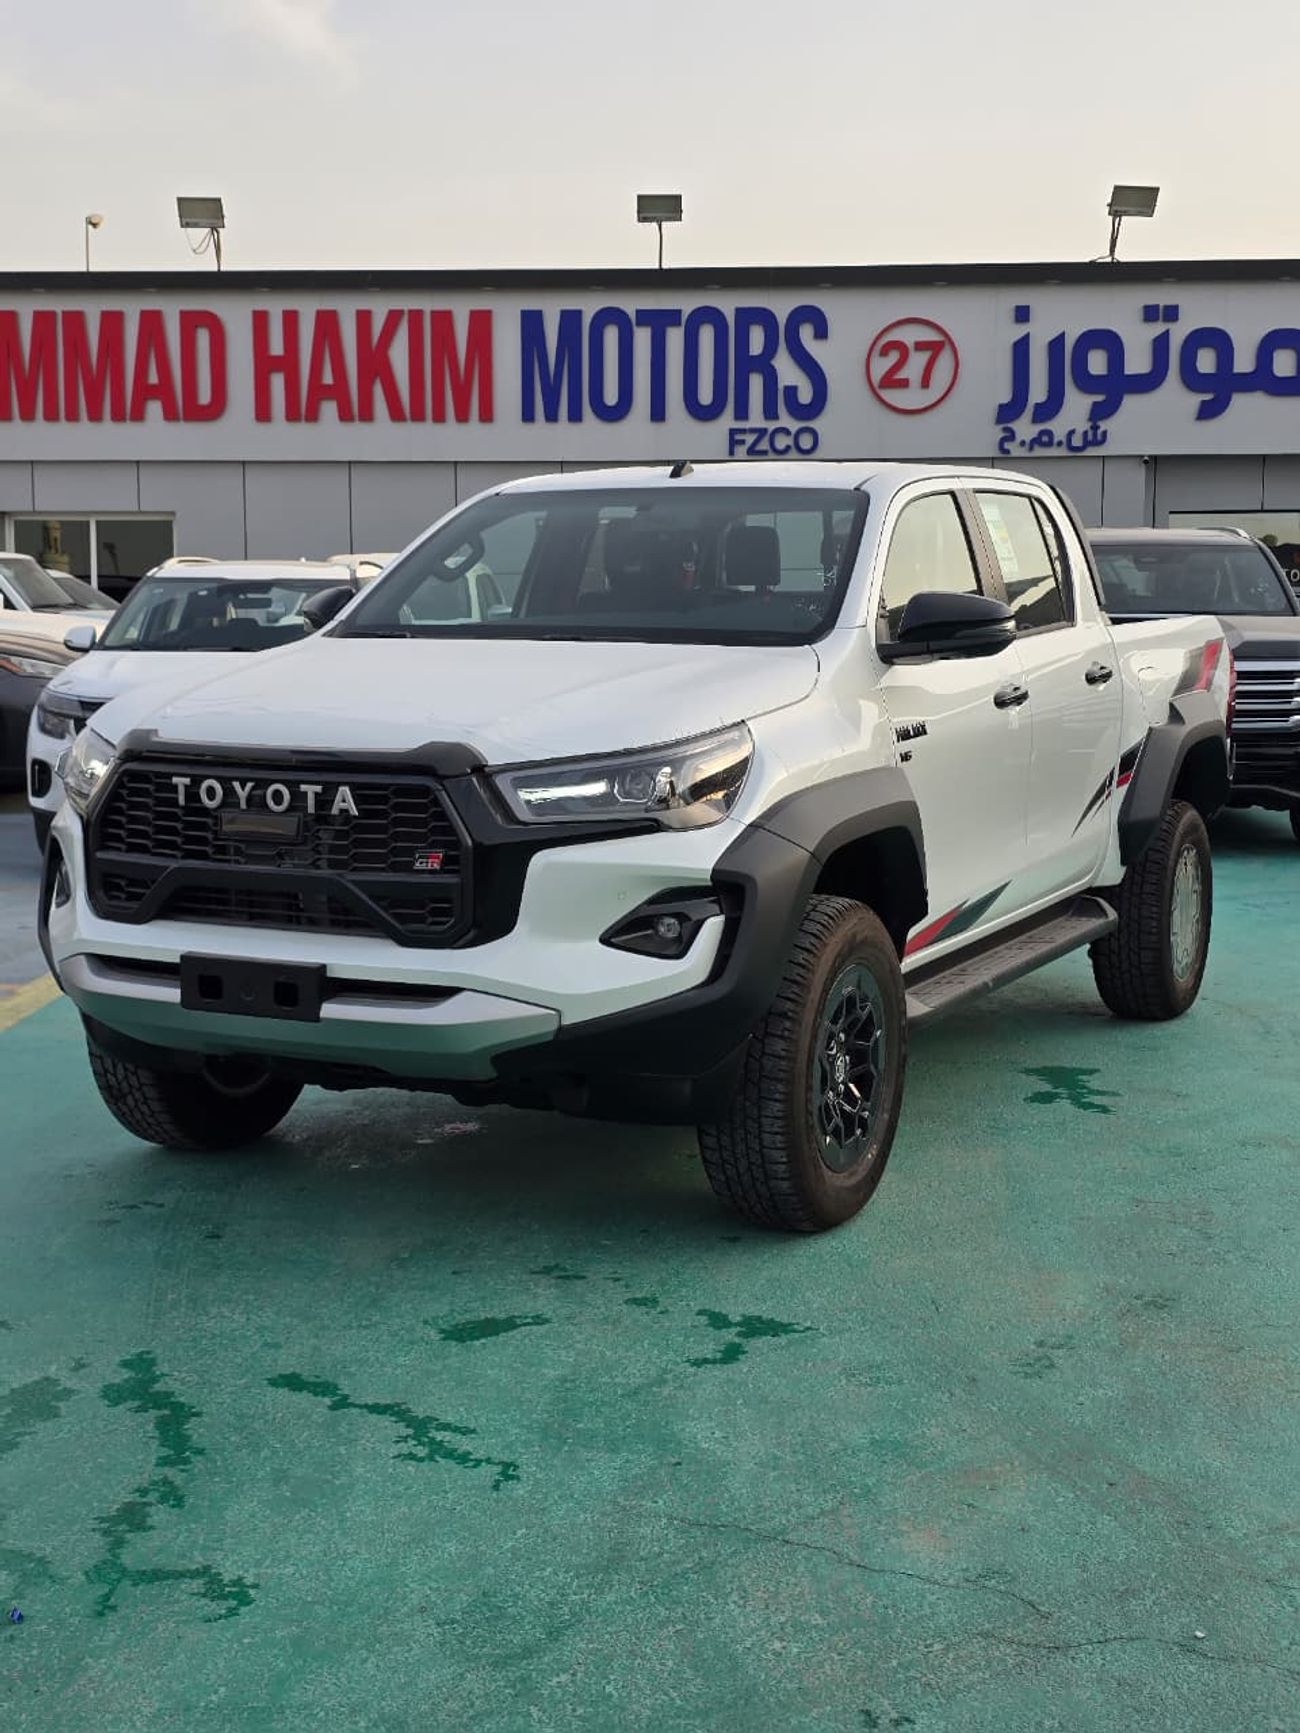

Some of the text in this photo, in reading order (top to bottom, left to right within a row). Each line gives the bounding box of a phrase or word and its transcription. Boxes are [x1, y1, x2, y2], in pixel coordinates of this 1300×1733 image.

[0, 305, 829, 423] MMAD HAKIM MOTORS
[878, 340, 946, 390] 27
[728, 427, 819, 456] FZCO
[172, 776, 359, 816] TOYOTA
[414, 855, 442, 869] GR
